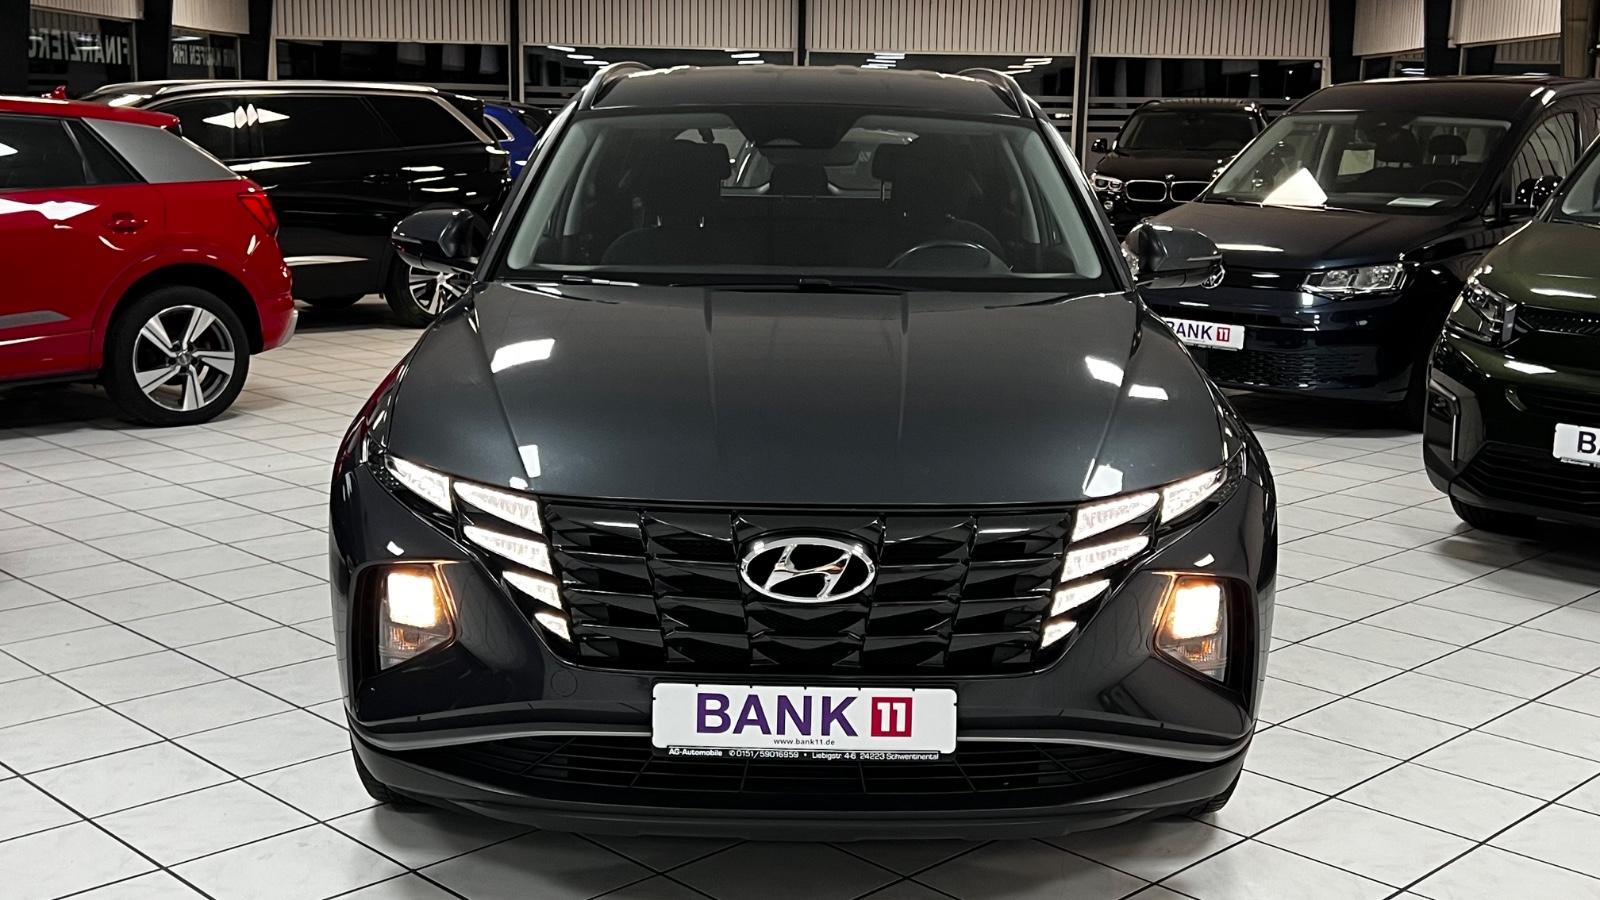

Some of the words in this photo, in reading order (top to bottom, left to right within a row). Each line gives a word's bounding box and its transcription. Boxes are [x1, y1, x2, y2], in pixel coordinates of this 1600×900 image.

[1218, 328, 1229, 341] 11
[1577, 430, 1600, 456] B
[697, 692, 859, 737] BANK
[876, 701, 907, 732] 11
[773, 738, 836, 746] www.bank11.de
[669, 748, 723, 757] AG-Automobile
[860, 752, 885, 760] 24223
[886, 752, 939, 760] Schwentinental
